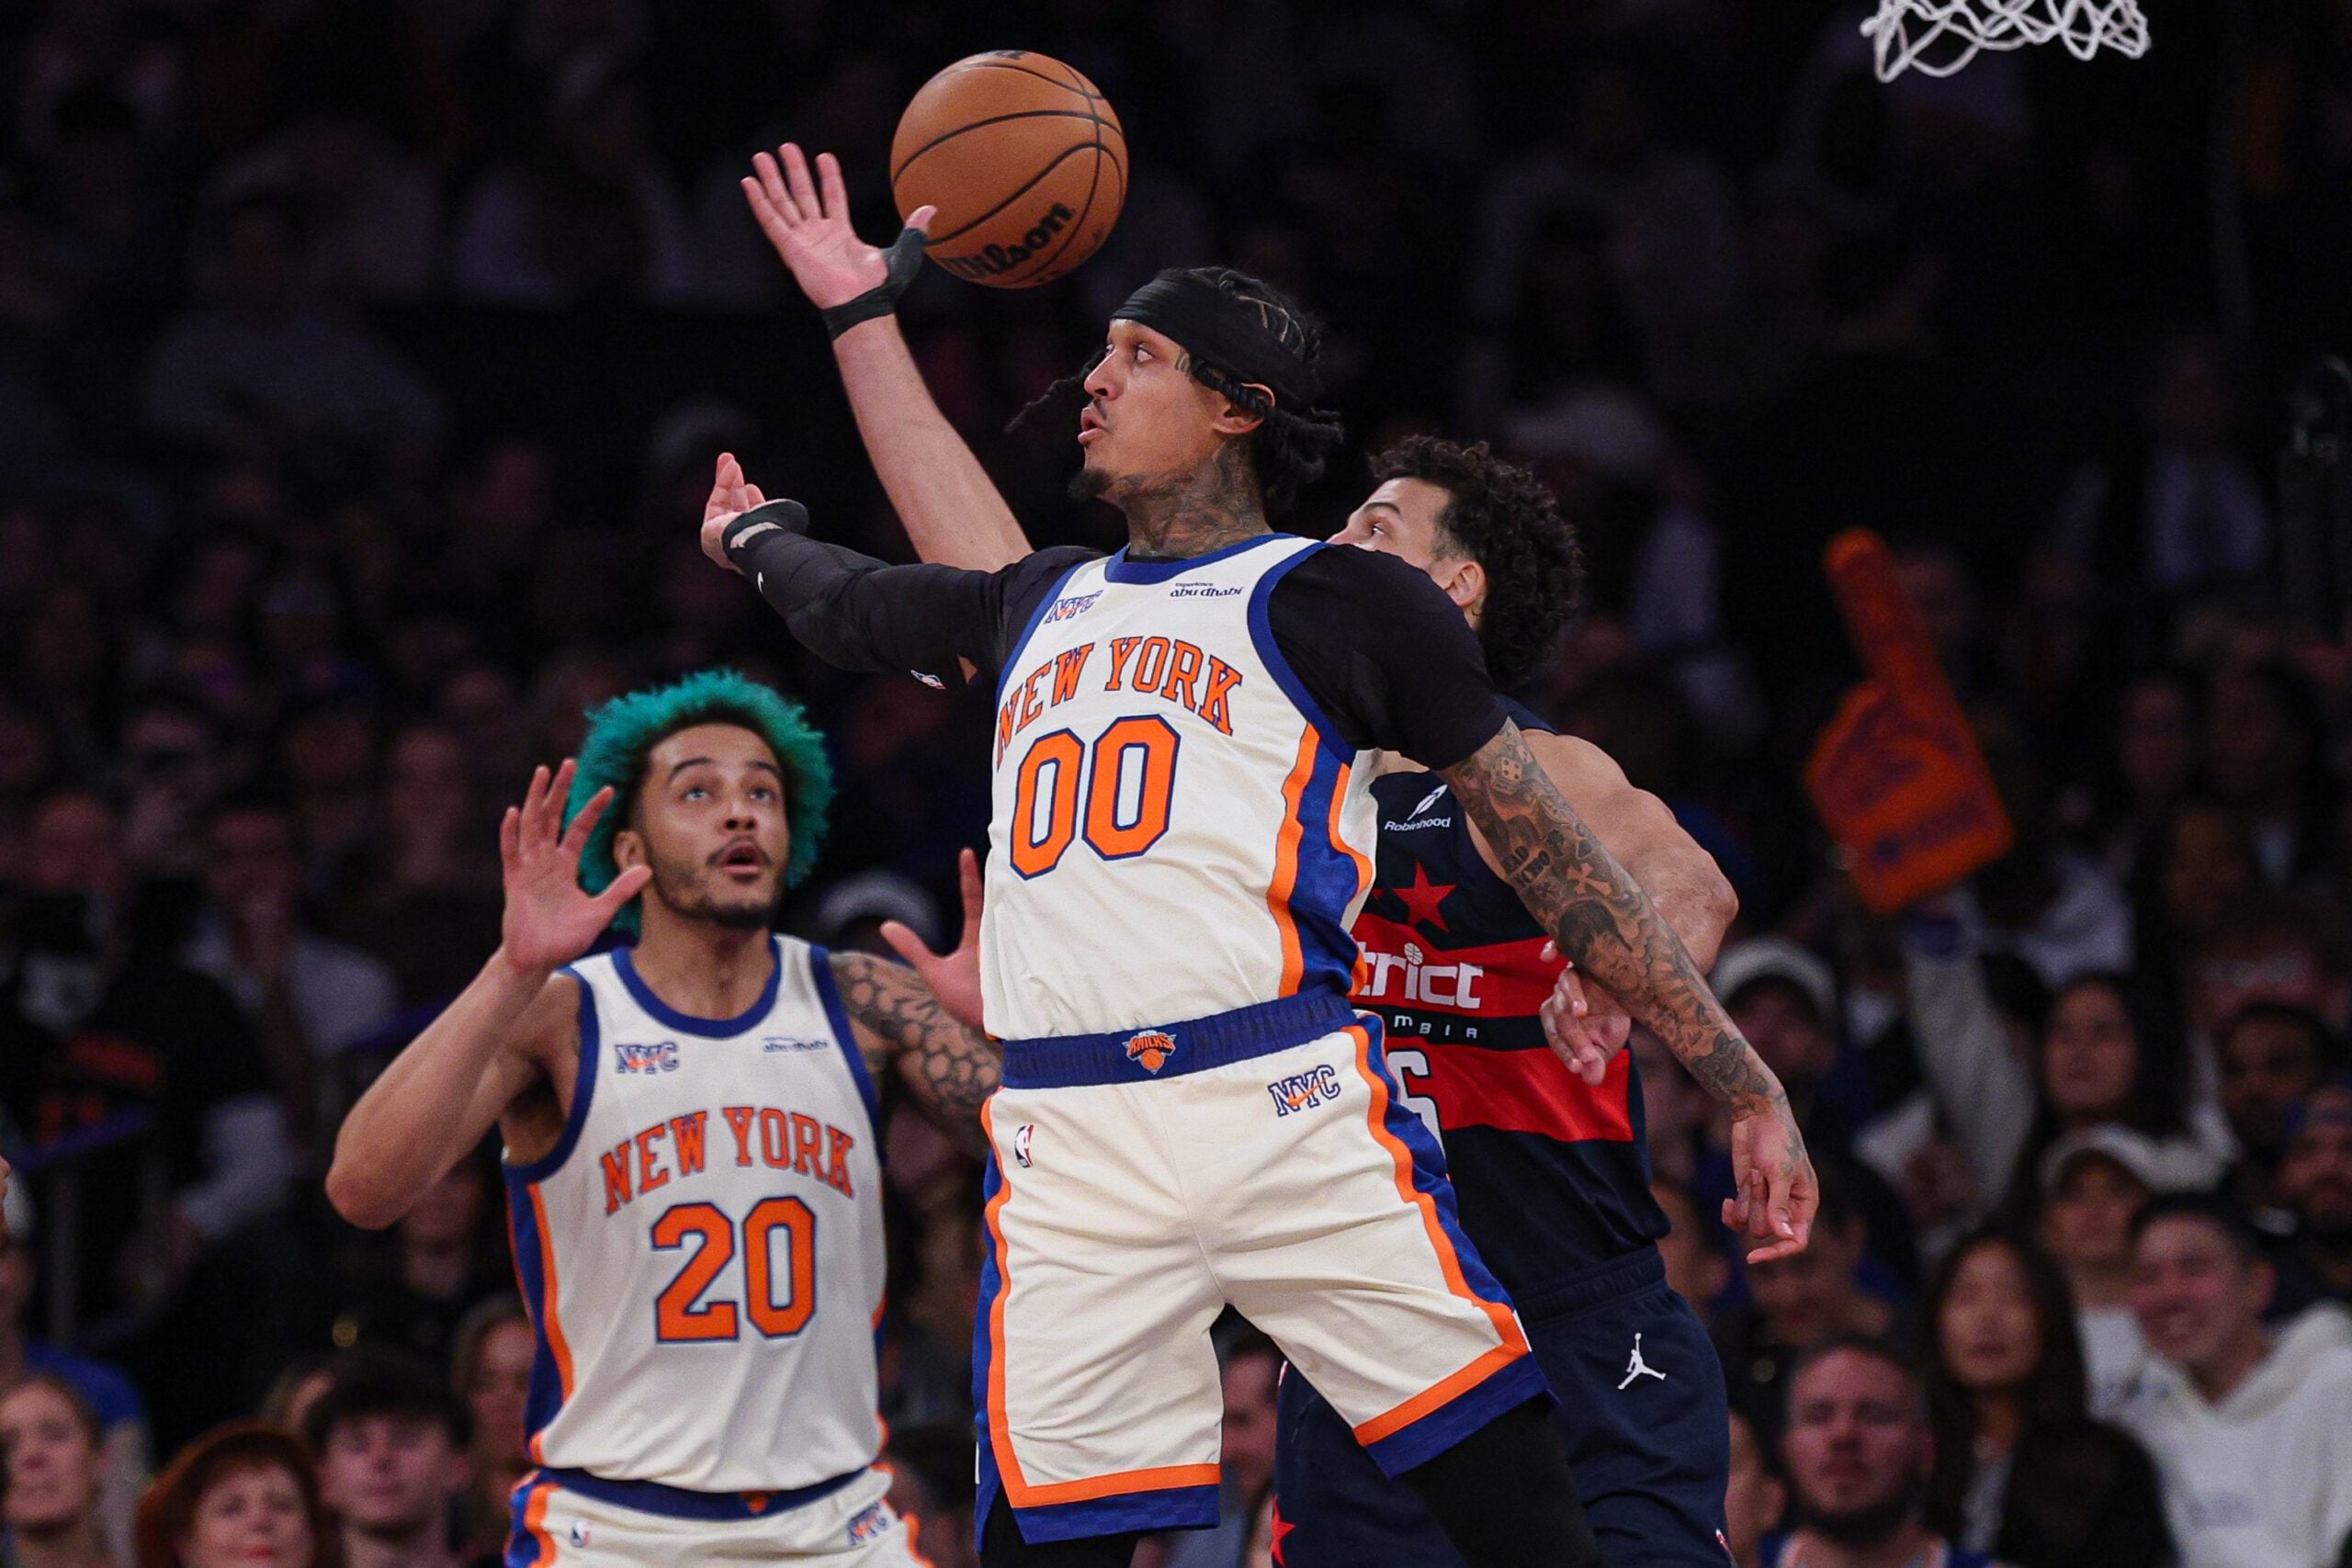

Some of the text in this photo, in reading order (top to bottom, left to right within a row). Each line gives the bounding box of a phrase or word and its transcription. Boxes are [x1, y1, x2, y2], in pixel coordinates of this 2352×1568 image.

[937, 202, 1075, 278] Wilson
[1170, 587, 1243, 597] abu dhabi
[997, 636, 1243, 773] NEW YORK
[1010, 714, 1181, 881] 00
[1384, 818, 1451, 831] Robinhood
[615, 1041, 679, 1075] NYC
[1268, 1064, 1341, 1118] NYC
[600, 1106, 854, 1218] NEW YORK
[650, 1195, 817, 1346] 20
